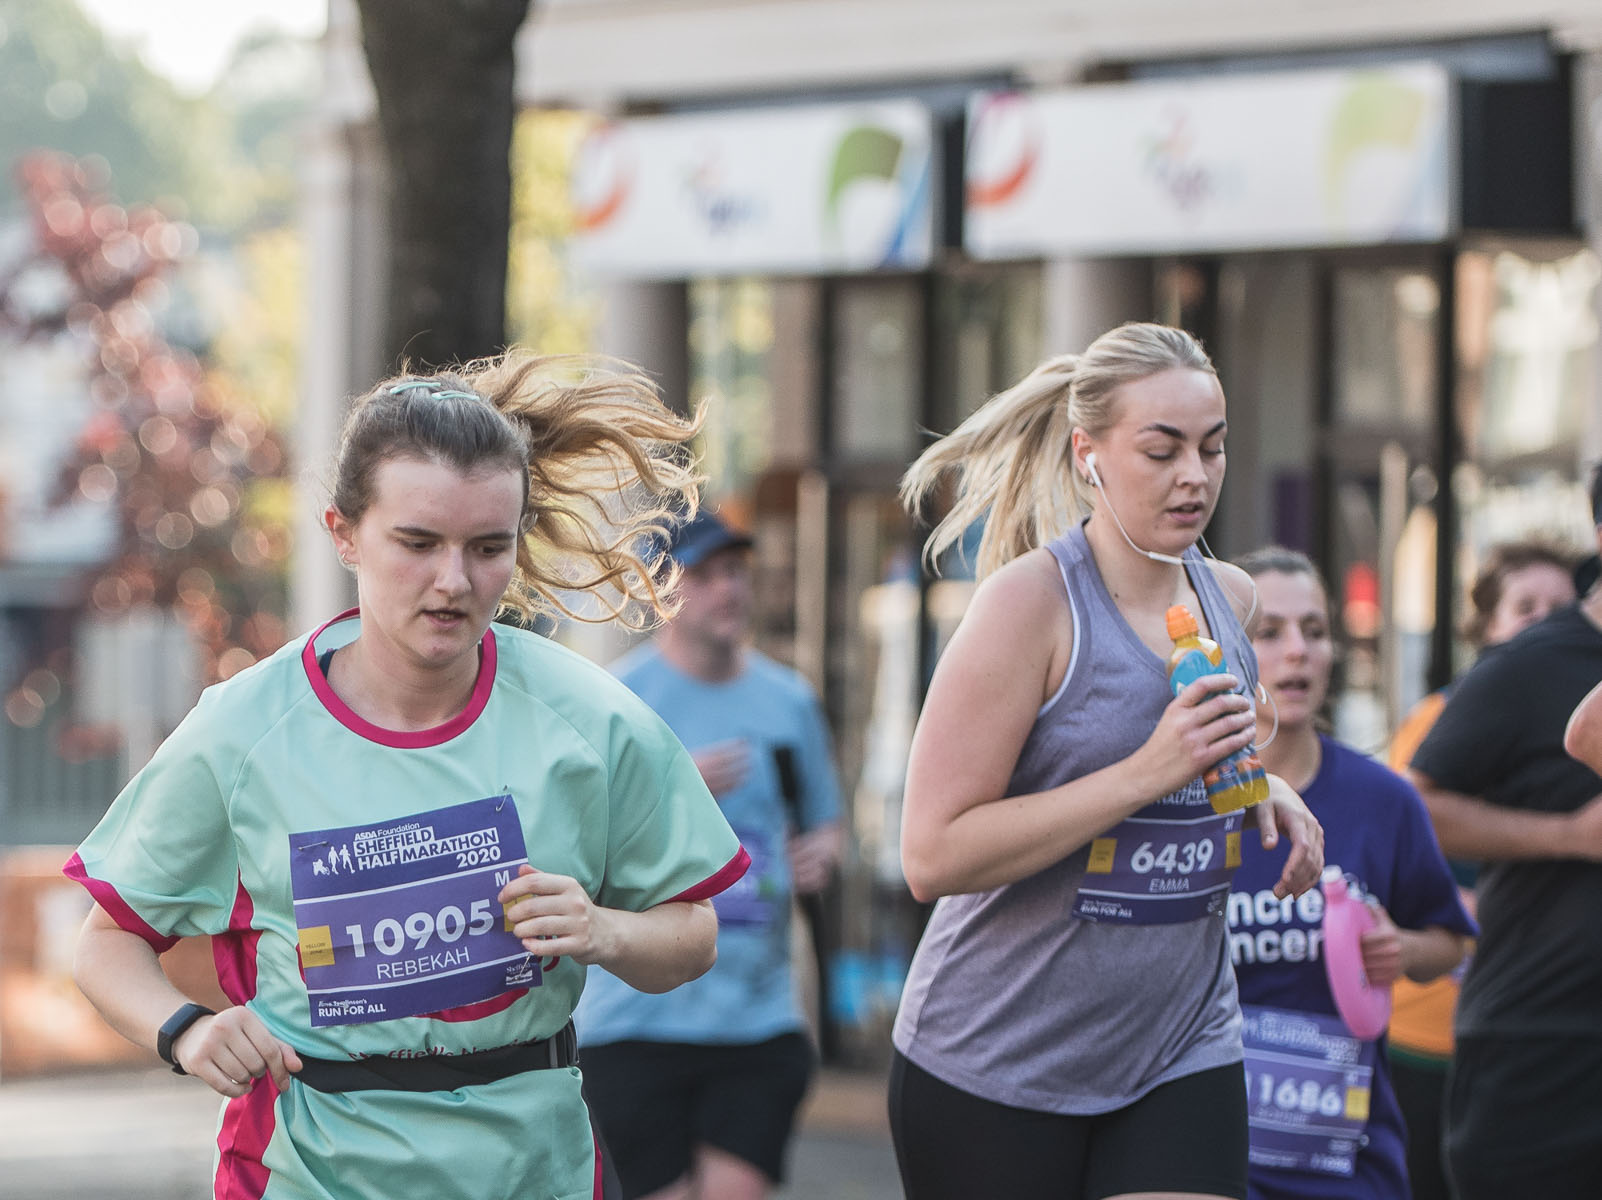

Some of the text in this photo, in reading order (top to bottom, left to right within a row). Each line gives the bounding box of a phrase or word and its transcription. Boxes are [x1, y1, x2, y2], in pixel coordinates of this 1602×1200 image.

[354, 822, 420, 842] ASDA Foundation
[355, 829, 433, 856] SHEFFIELD
[358, 830, 498, 871] HALF MARATHON
[456, 845, 501, 868] 2020
[1130, 838, 1214, 875] 6439
[495, 870, 510, 887] M
[1149, 877, 1190, 893] EMMA
[346, 899, 495, 958] 10905
[376, 947, 470, 980] REBEKAH
[318, 1003, 386, 1017] RUN FOR ALL
[1245, 1070, 1343, 1118] 1686
